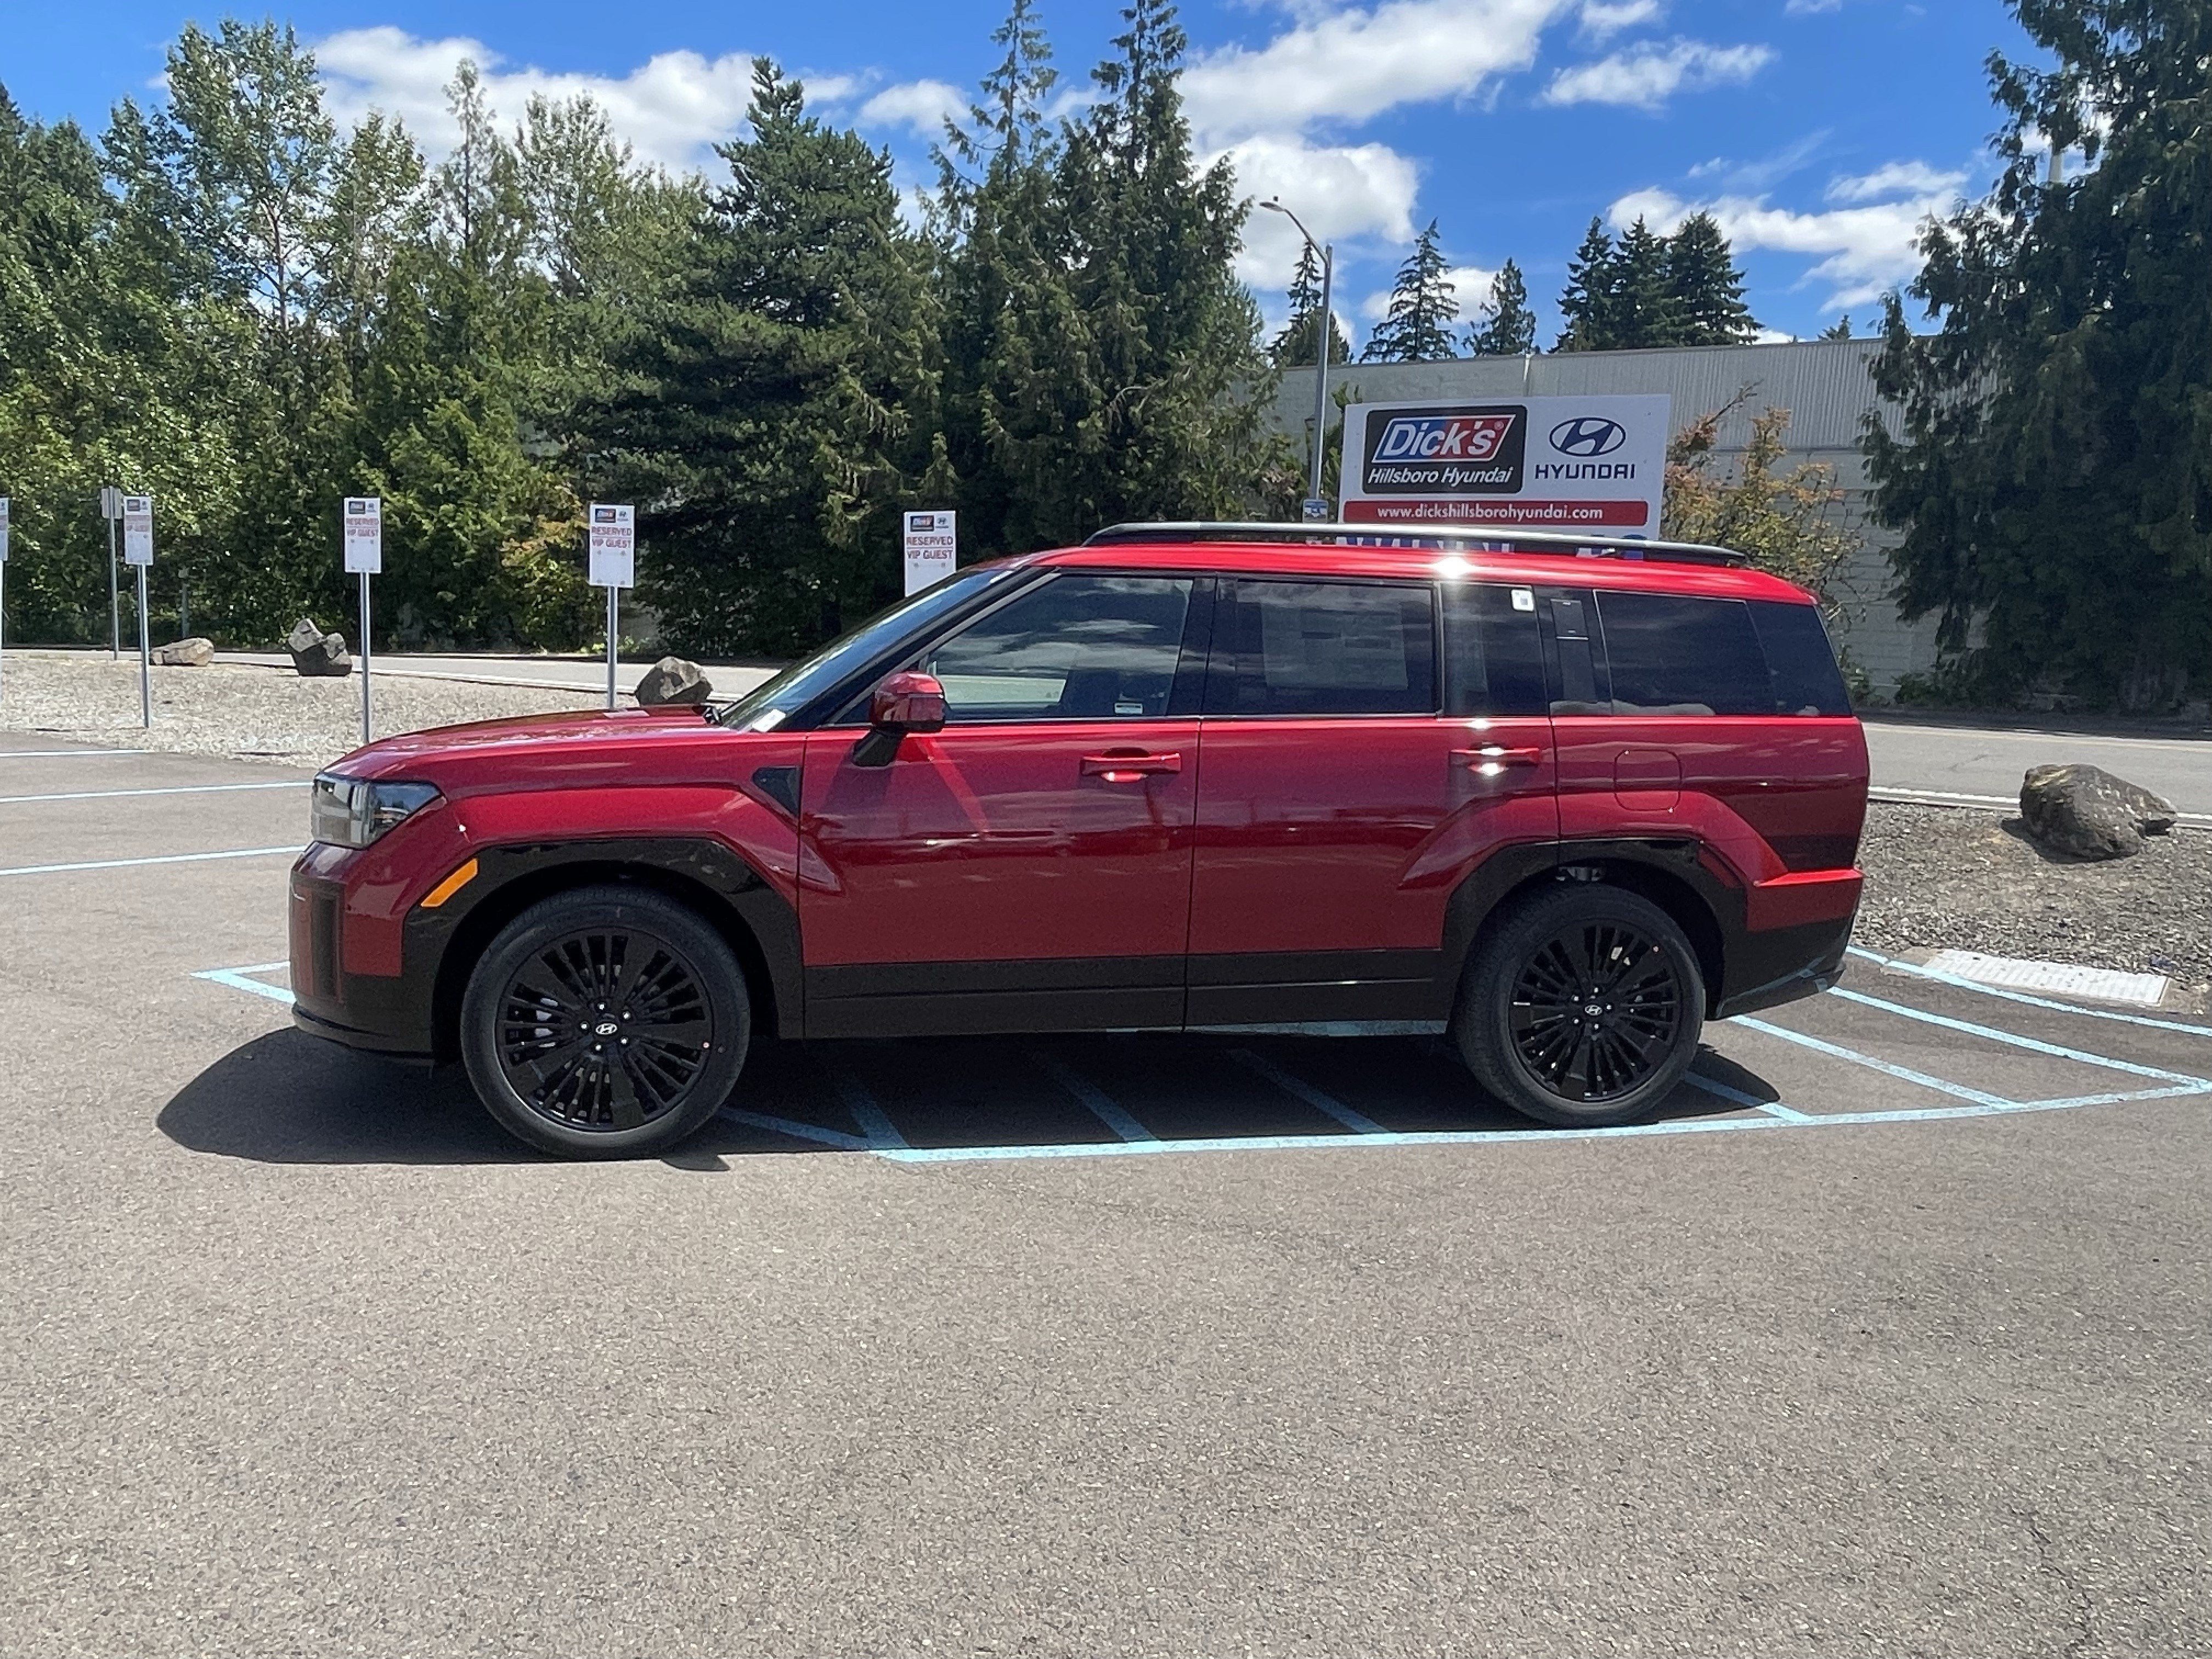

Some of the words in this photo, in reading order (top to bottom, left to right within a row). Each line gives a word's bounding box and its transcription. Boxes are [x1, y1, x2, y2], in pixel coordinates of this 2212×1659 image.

[1383, 421, 1496, 456] Dick's
[1367, 467, 1439, 484] Hillsboro
[1441, 466, 1514, 487] Hyundai
[1535, 464, 1635, 479] HYUNDAI
[1377, 503, 1603, 522] www.dickshillsborohyundai.com
[592, 526, 631, 535] RESERVED
[606, 539, 631, 549] GUEST
[906, 536, 953, 545] RESERVED
[907, 550, 921, 560] VIP
[923, 550, 953, 560] GUEST
